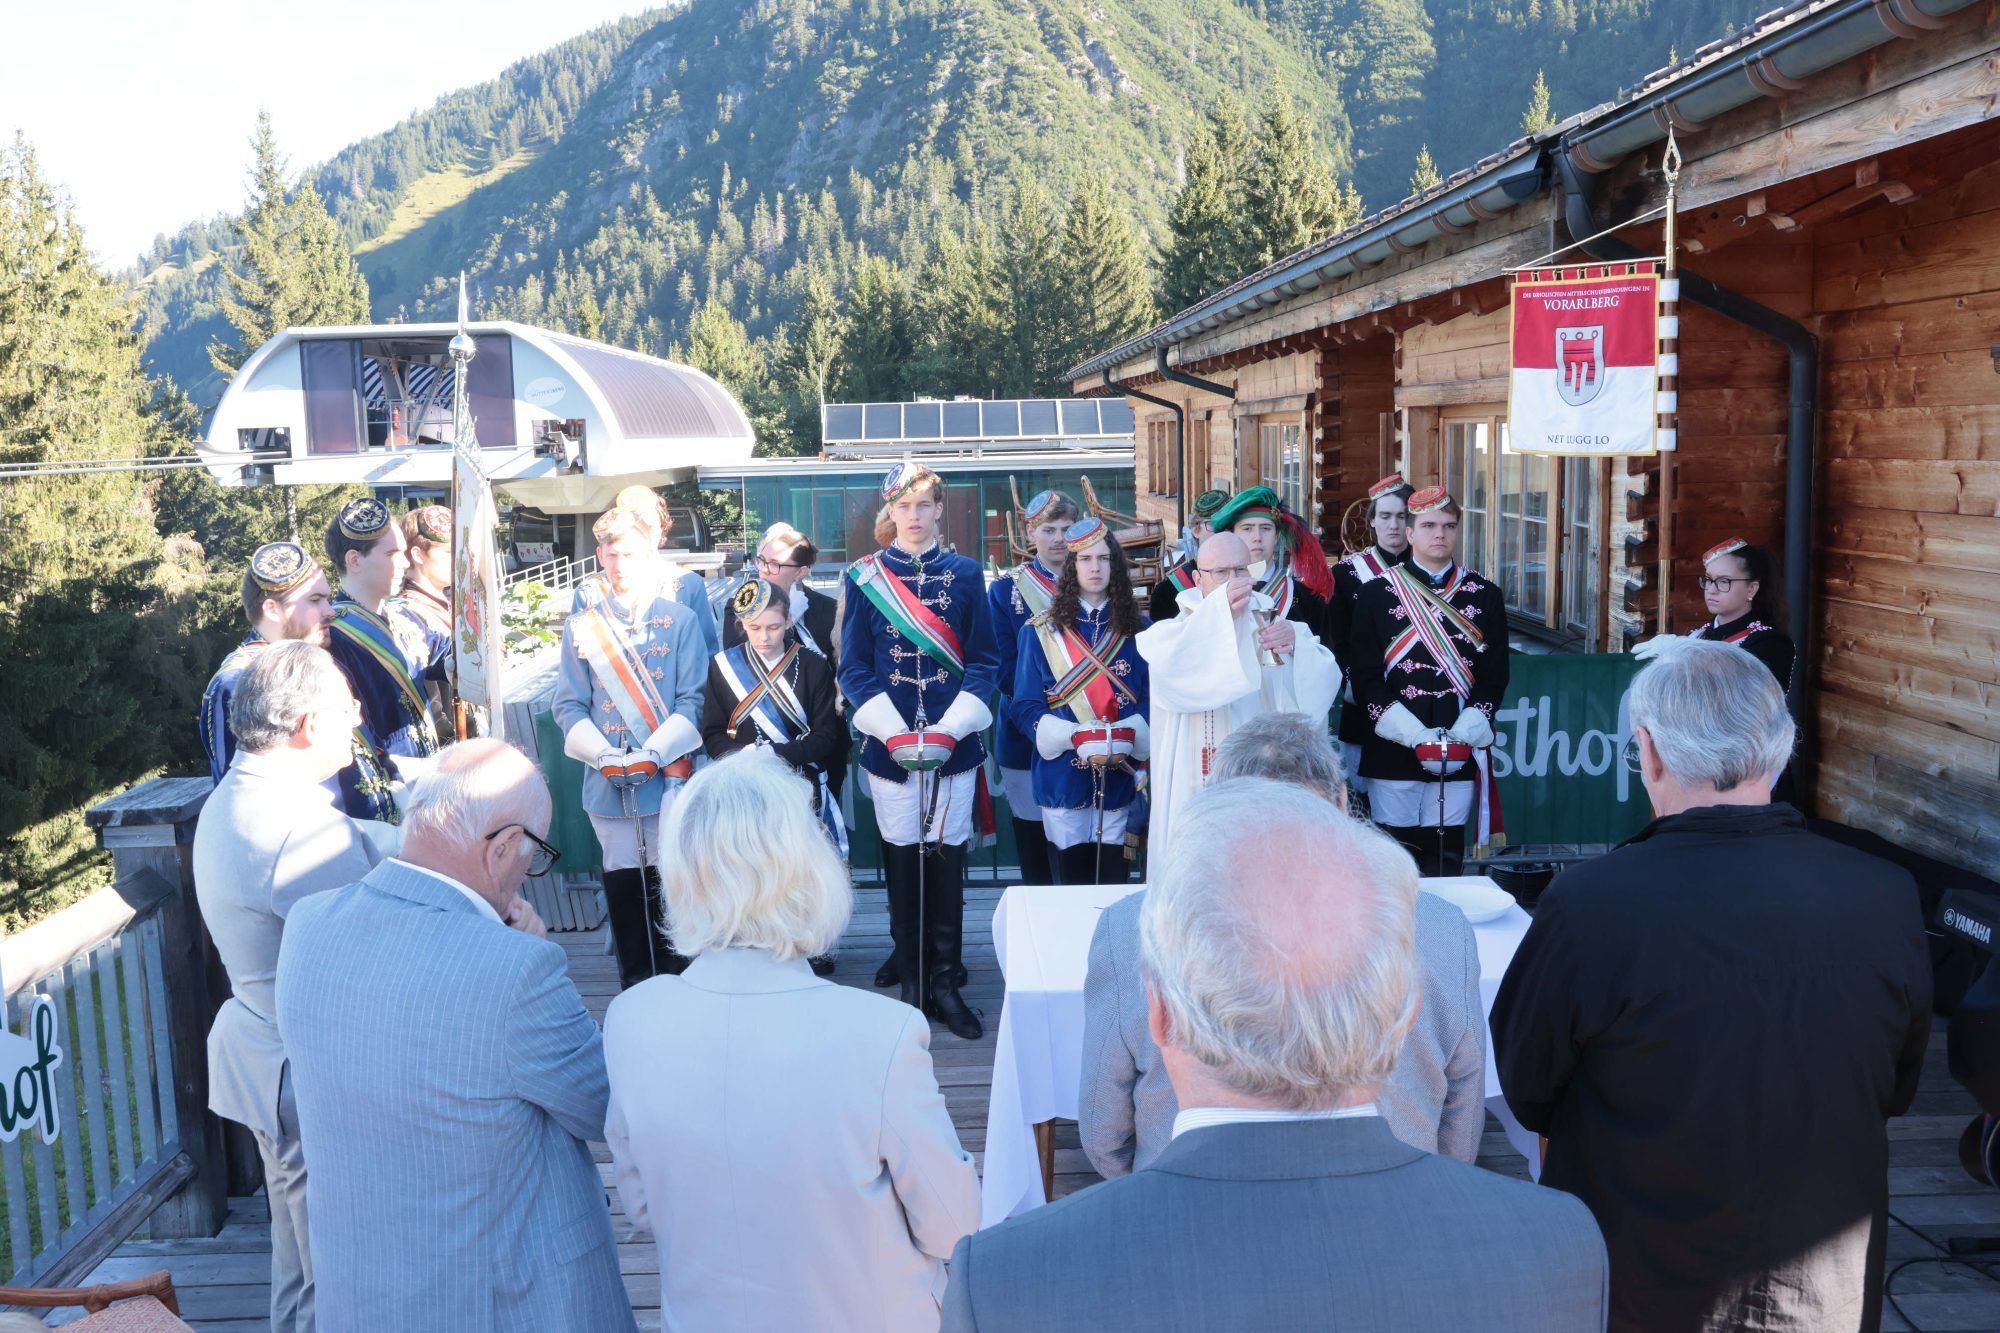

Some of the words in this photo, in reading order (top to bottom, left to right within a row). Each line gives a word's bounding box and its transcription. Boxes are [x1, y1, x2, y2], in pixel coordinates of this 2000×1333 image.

[1543, 295, 1620, 311] VORARLBERG
[1547, 434, 1565, 444] NET
[1566, 435, 1592, 445] LUGG
[1595, 435, 1610, 445] LO
[1955, 912, 1992, 944] YAMAHA
